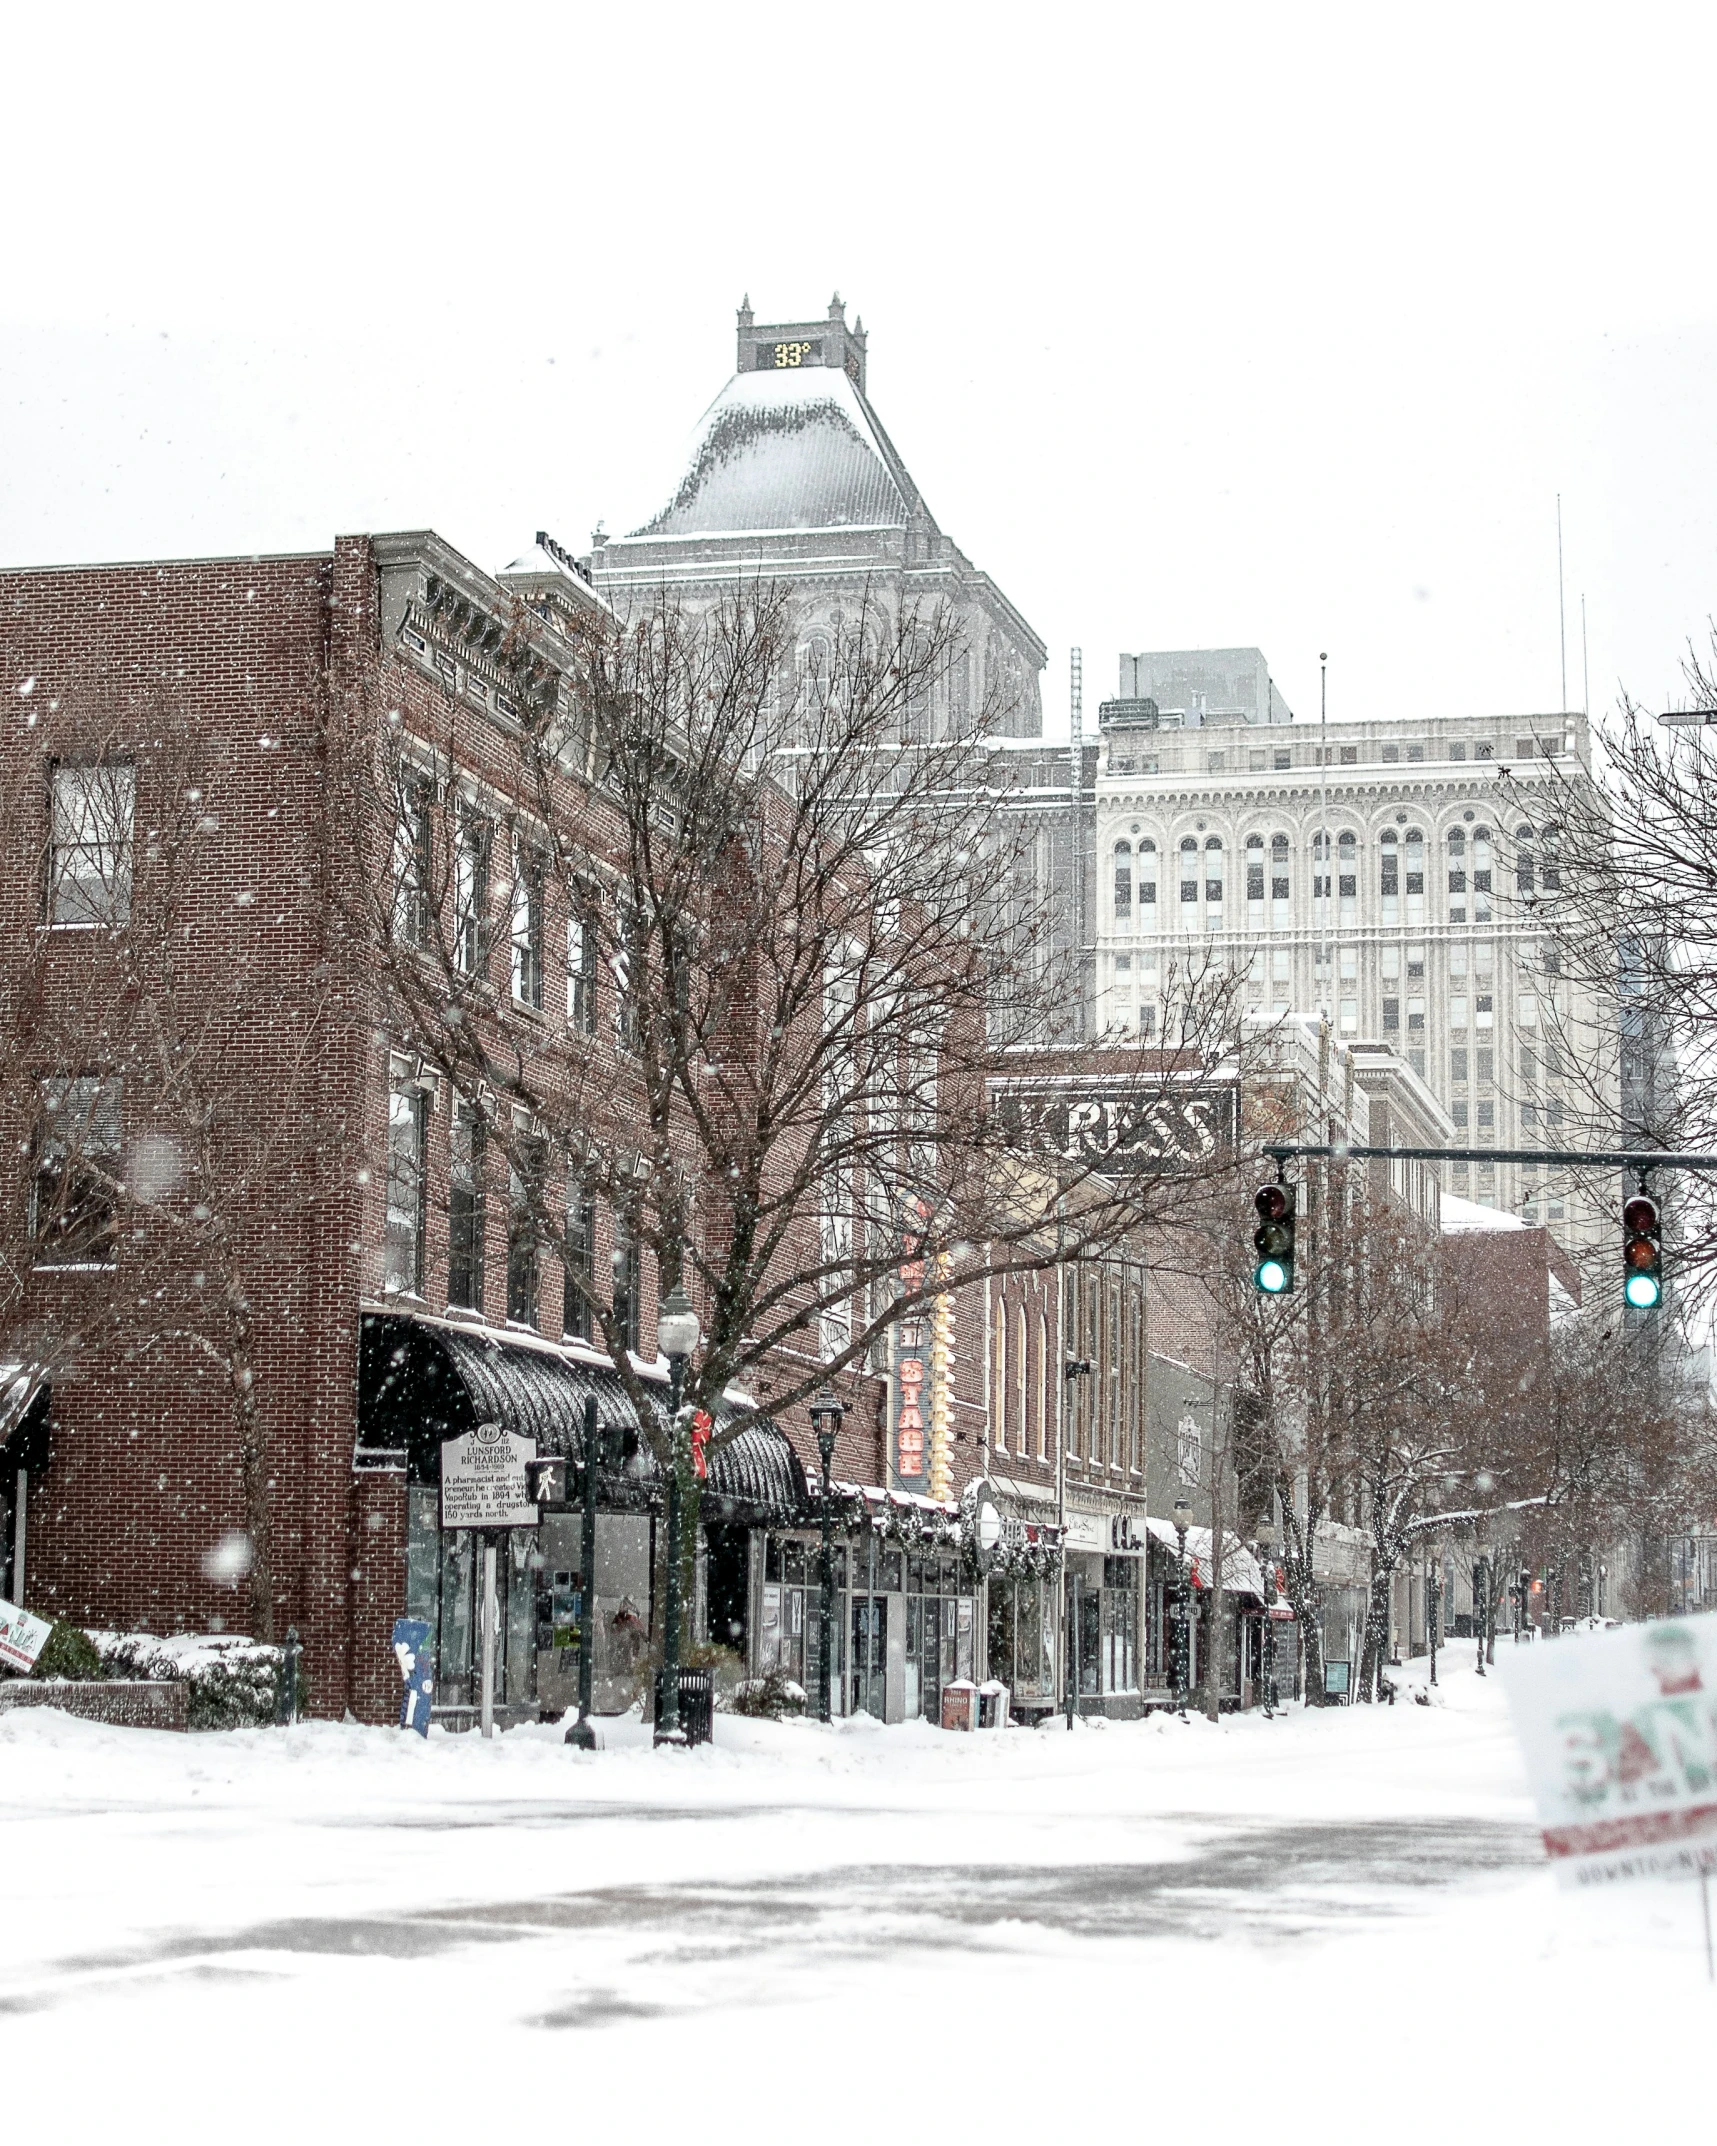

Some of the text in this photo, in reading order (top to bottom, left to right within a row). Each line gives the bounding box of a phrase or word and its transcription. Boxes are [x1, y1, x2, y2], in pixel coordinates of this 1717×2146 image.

[775, 342, 811, 367] 33°
[1016, 1099, 1215, 1162] KRESS
[898, 1358, 924, 1477] STAGE
[467, 1446, 512, 1456] LUNSFORD
[461, 1454, 518, 1465] RICHARDSON
[445, 1476, 451, 1484] A
[452, 1474, 494, 1486] pharmacist
[496, 1473, 510, 1483] and
[476, 1483, 485, 1492] he
[445, 1492, 478, 1503] VapoRub
[481, 1492, 489, 1501] in
[493, 1490, 510, 1500] 1894
[444, 1502, 481, 1511] operating
[445, 1511, 458, 1519] 150
[460, 1510, 483, 1520] yards
[944, 1696, 968, 1705] RHINO
